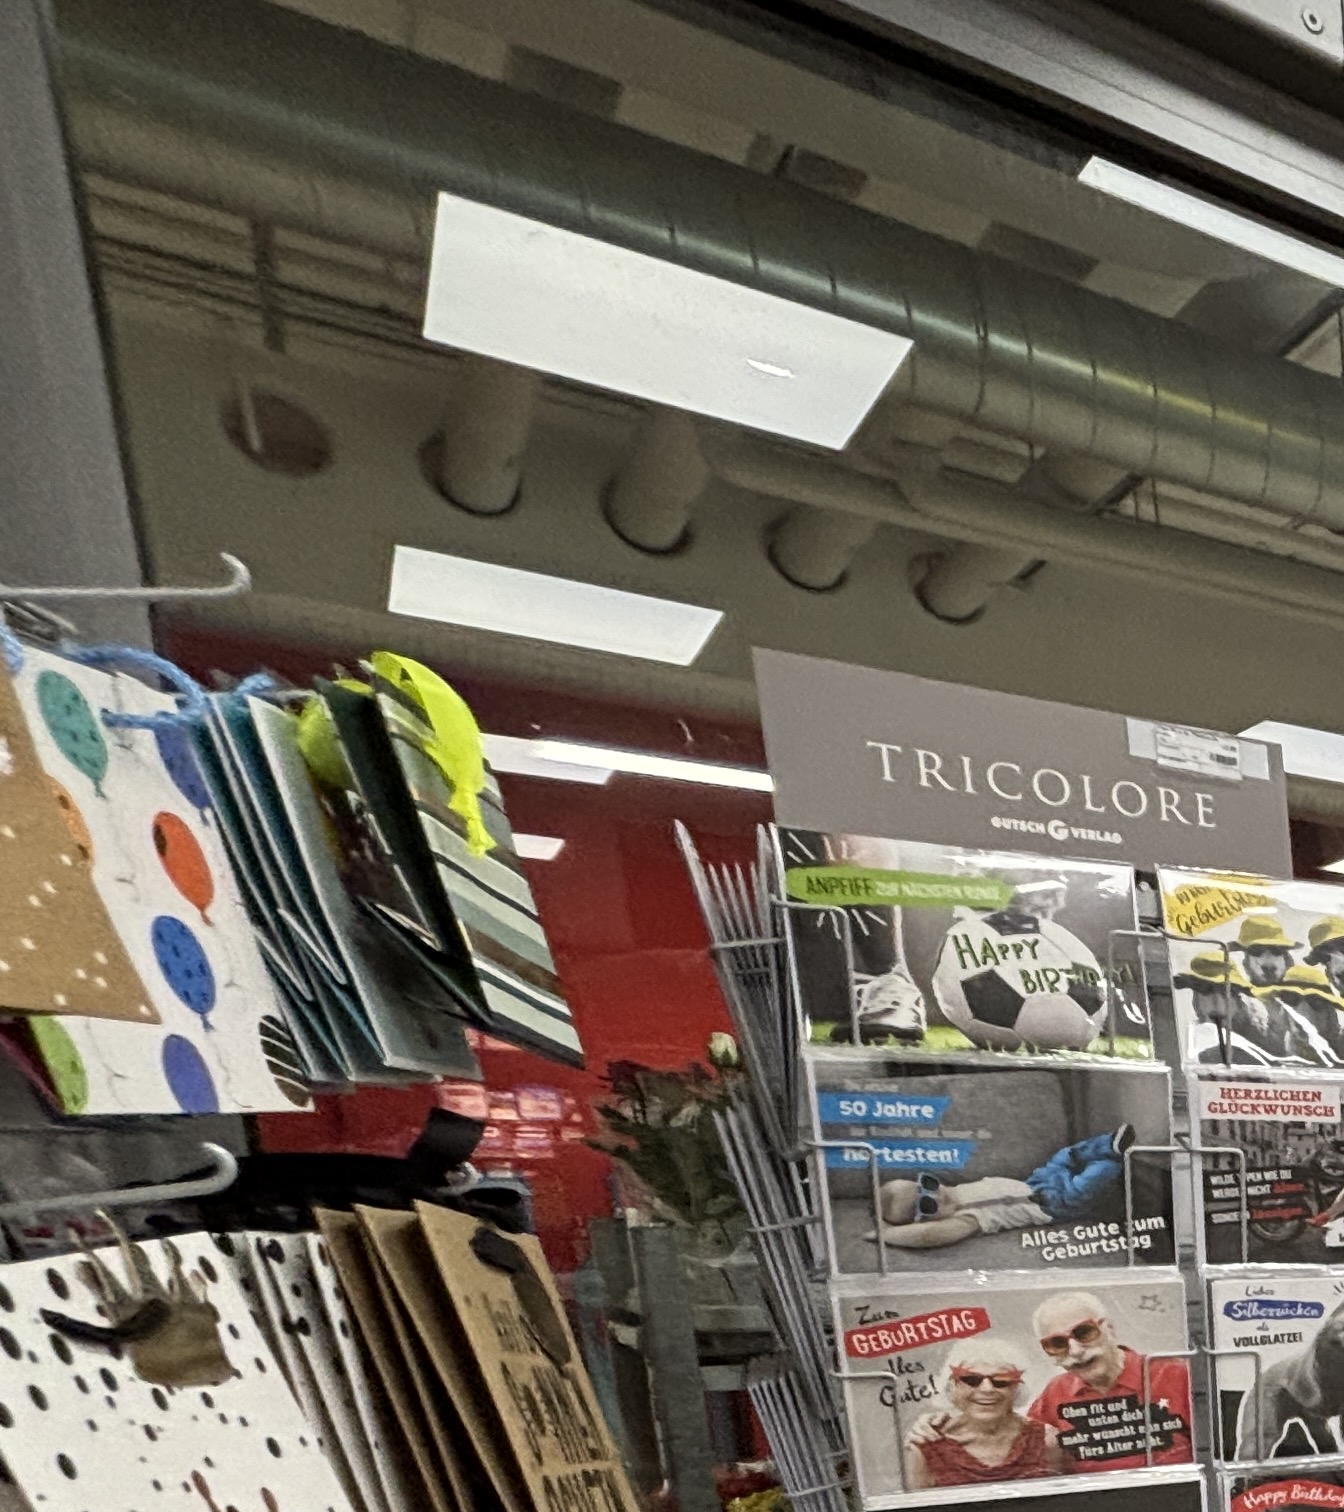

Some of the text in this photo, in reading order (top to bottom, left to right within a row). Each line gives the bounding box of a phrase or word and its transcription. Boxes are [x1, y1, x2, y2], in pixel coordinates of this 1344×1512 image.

[866, 741, 1218, 829] TRICOLORE
[991, 815, 1122, 845] GUTSCH VERLAG
[805, 874, 874, 896] ANPFIFF
[952, 932, 1040, 970] HAPPY
[1218, 1086, 1323, 1103] HERZLICHEN
[838, 1100, 935, 1119] 50 Jahre
[1206, 1100, 1336, 1118] GLÜCKWUNSCH
[1021, 1229, 1069, 1249] Alles
[1073, 1221, 1120, 1243] Gute
[853, 1305, 900, 1327] Zum
[851, 1309, 978, 1356] GEBURTSTAG
[878, 1376, 941, 1409] Gute!
[1061, 1406, 1089, 1419] Oben
[1106, 1398, 1128, 1412] und
[1061, 1417, 1184, 1446] mehr sich
[1087, 1414, 1120, 1428] unten
[1106, 1441, 1135, 1454] Alter
[1243, 1488, 1288, 1511] Happy
